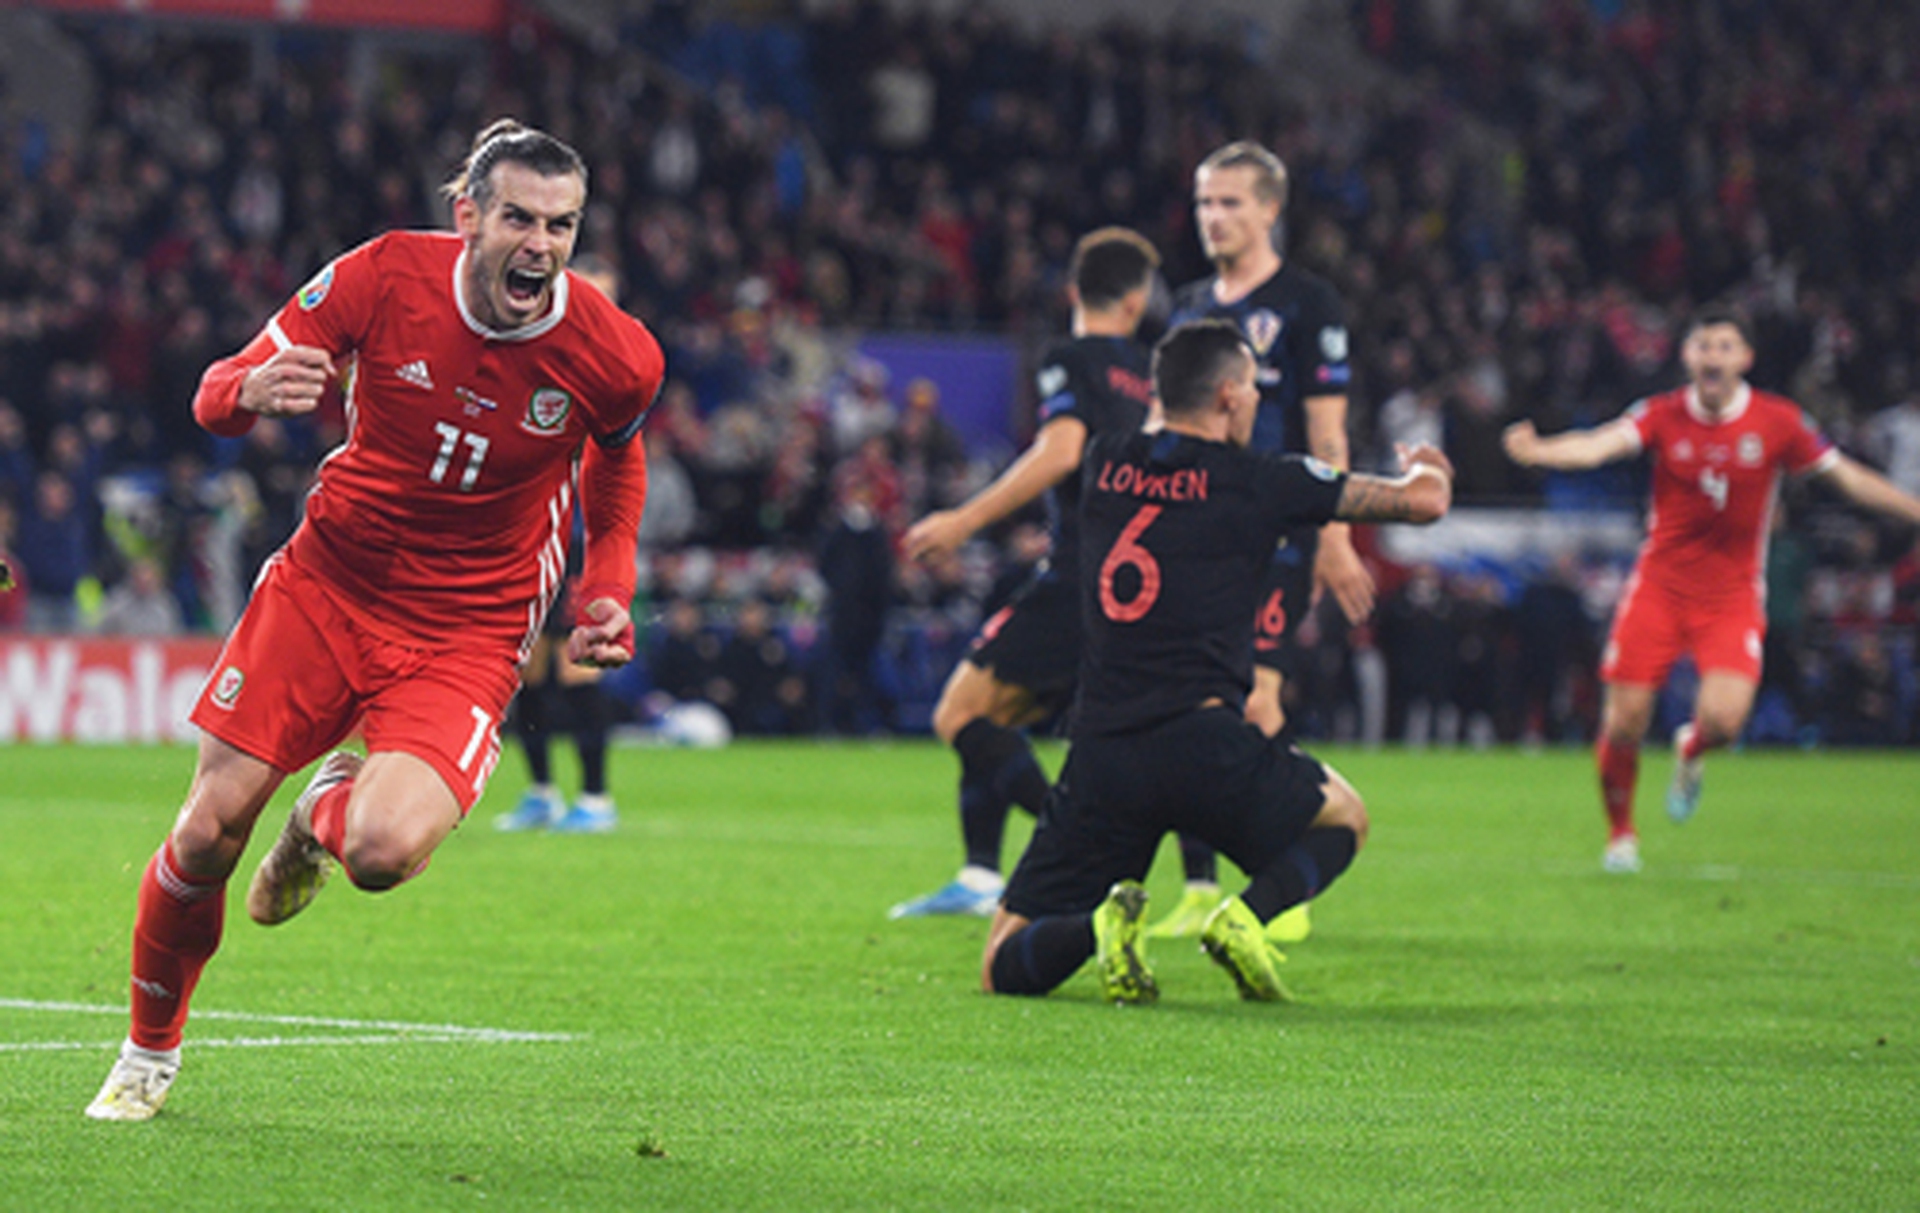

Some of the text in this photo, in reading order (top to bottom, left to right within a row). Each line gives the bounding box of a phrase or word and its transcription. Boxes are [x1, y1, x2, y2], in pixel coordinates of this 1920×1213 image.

[429, 421, 490, 492] 11
[1699, 466, 1729, 512] 4
[1099, 503, 1162, 622] 6
